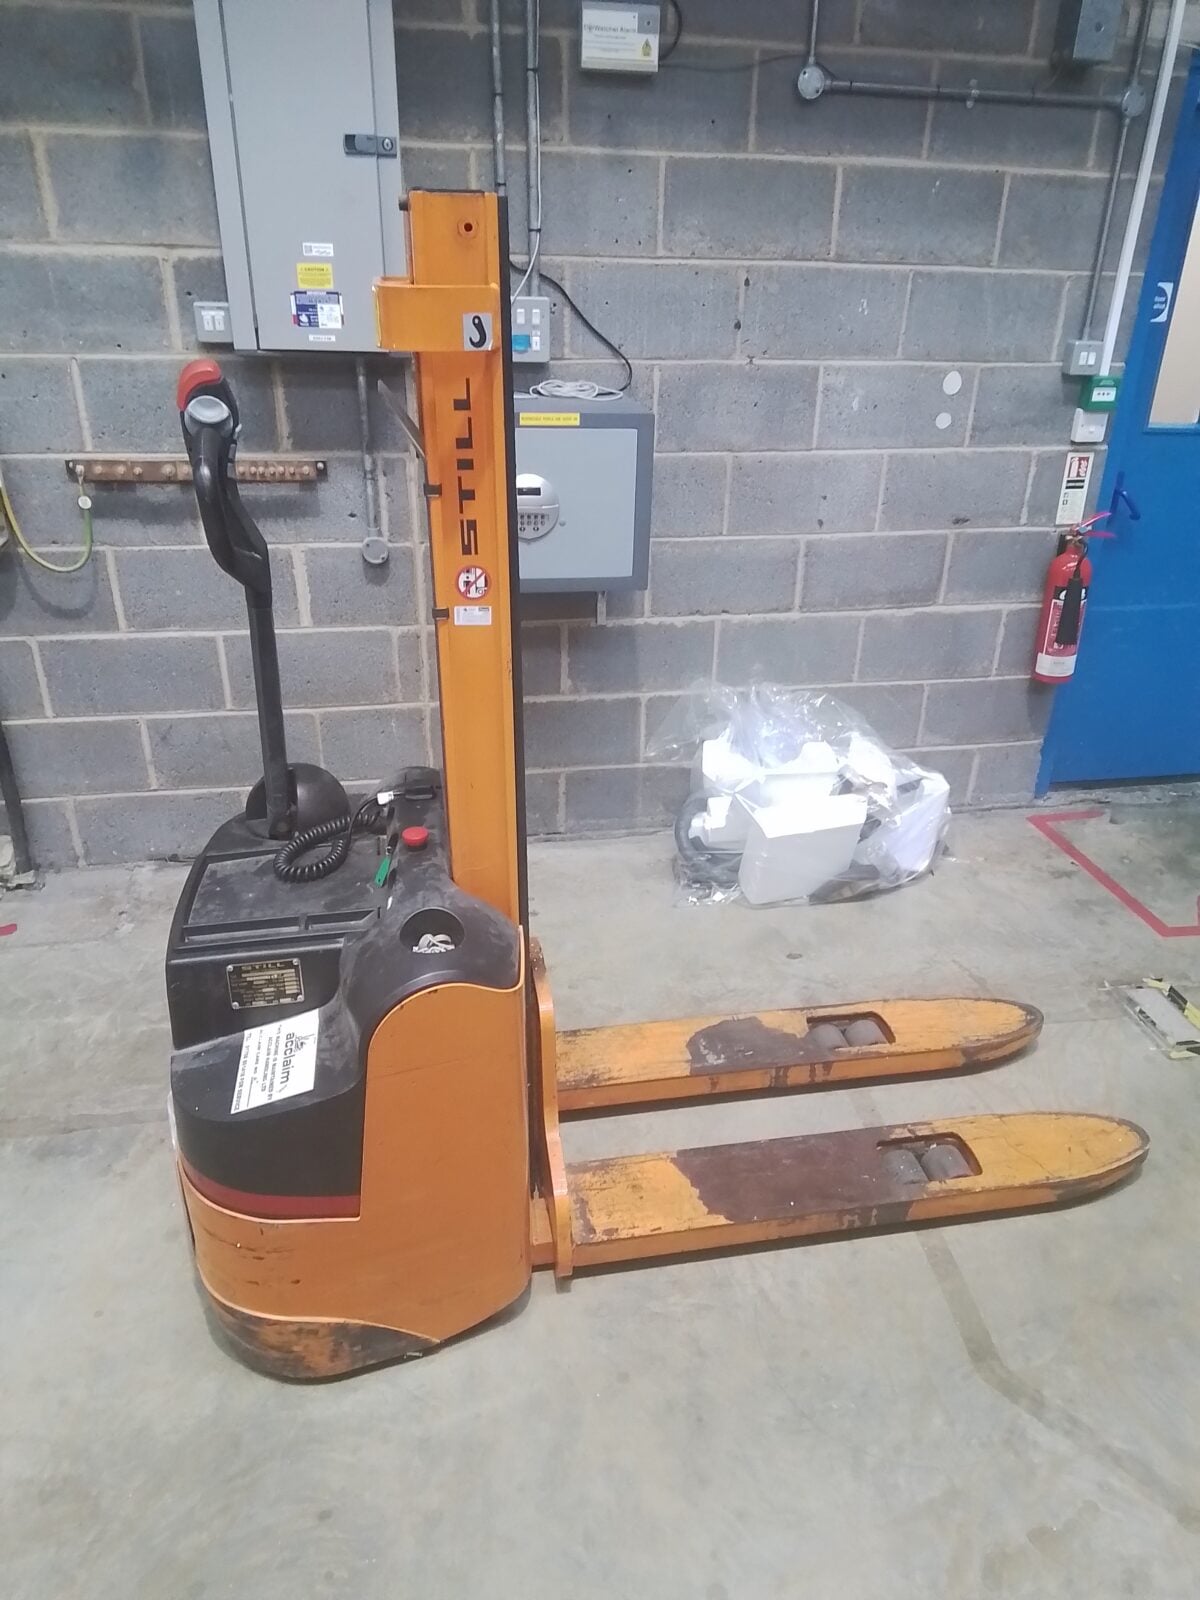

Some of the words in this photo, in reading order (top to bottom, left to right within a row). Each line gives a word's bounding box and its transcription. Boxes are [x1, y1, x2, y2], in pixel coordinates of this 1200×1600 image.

[453, 377, 479, 556] STILL
[262, 1057, 270, 1082] HANDLING
[280, 1032, 295, 1085] acclaim
[268, 1063, 277, 1093] MAINTAINED
[234, 1088, 243, 1112] SERVICE
